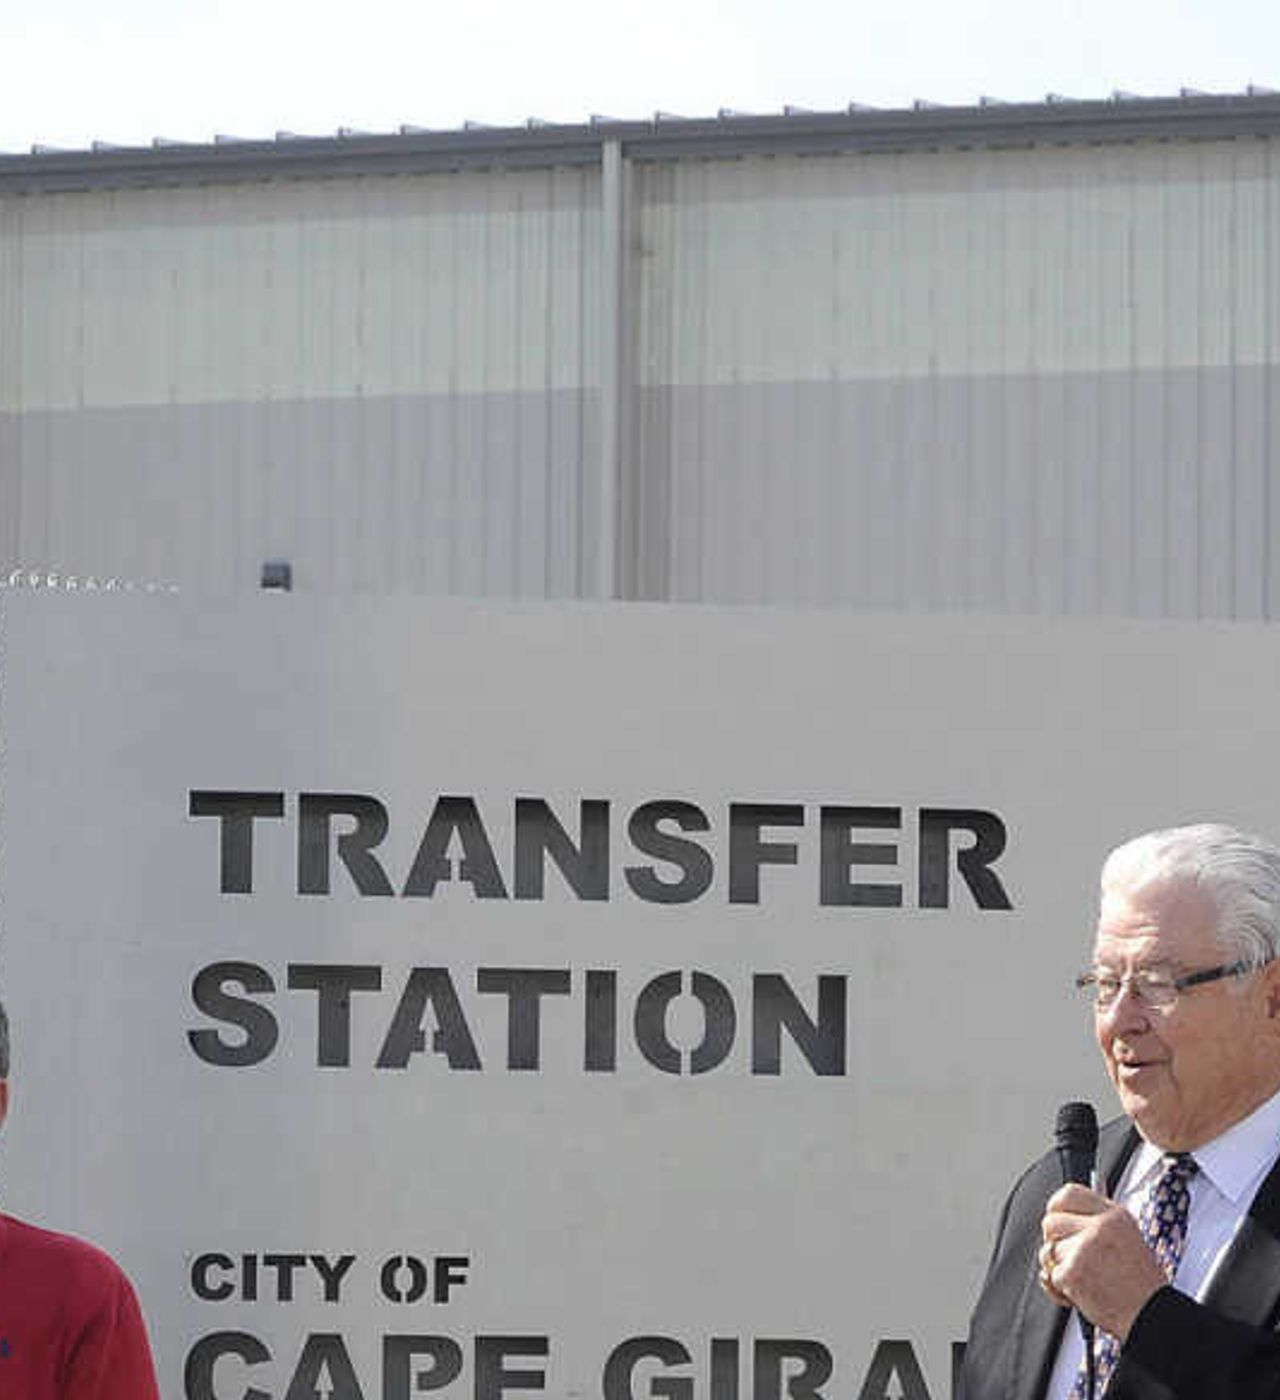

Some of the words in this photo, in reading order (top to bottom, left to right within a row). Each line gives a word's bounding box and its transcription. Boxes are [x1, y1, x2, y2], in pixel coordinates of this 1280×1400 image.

[188, 789, 1014, 911] TRANSFER
[186, 960, 849, 1077] STATION
[190, 1252, 357, 1304] CITY
[379, 1254, 470, 1304] OF
